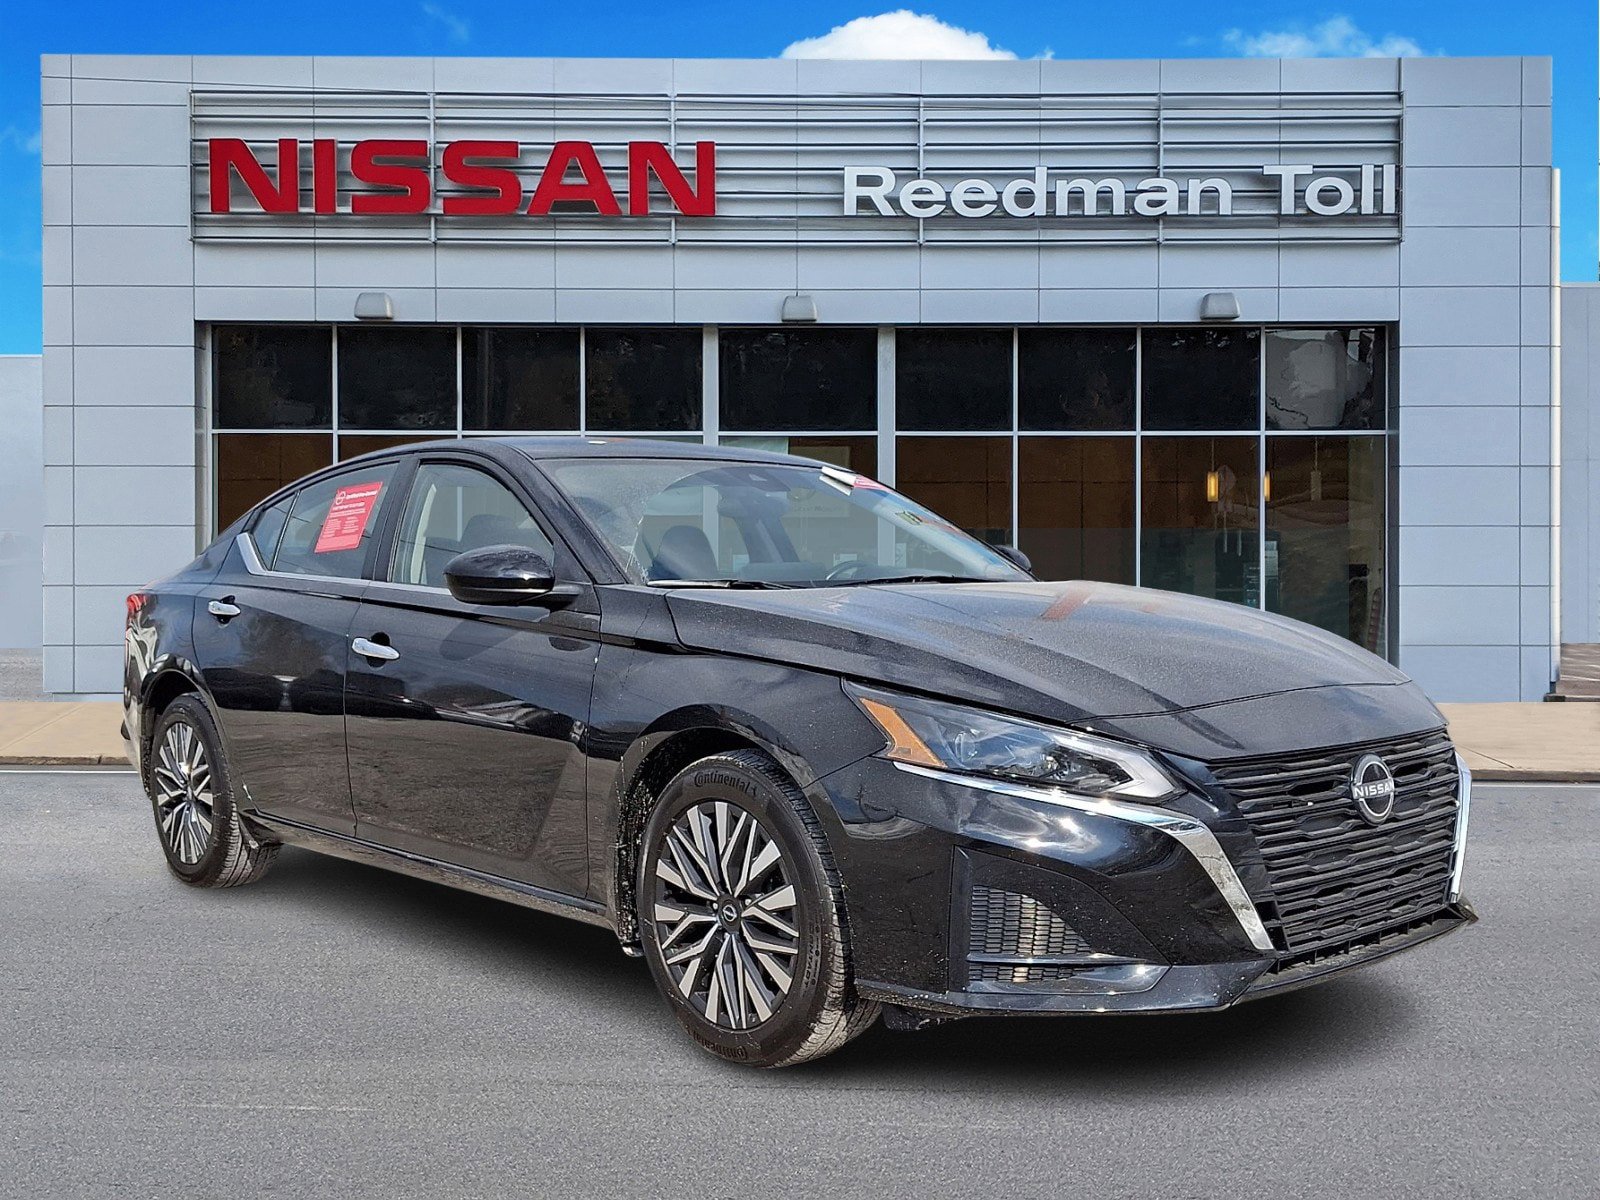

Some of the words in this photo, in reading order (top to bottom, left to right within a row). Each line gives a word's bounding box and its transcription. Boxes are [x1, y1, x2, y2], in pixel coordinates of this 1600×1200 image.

[209, 138, 716, 216] NISSAN
[843, 166, 1233, 218] Reedman
[1263, 164, 1396, 216] Toll
[694, 770, 751, 794] Continental
